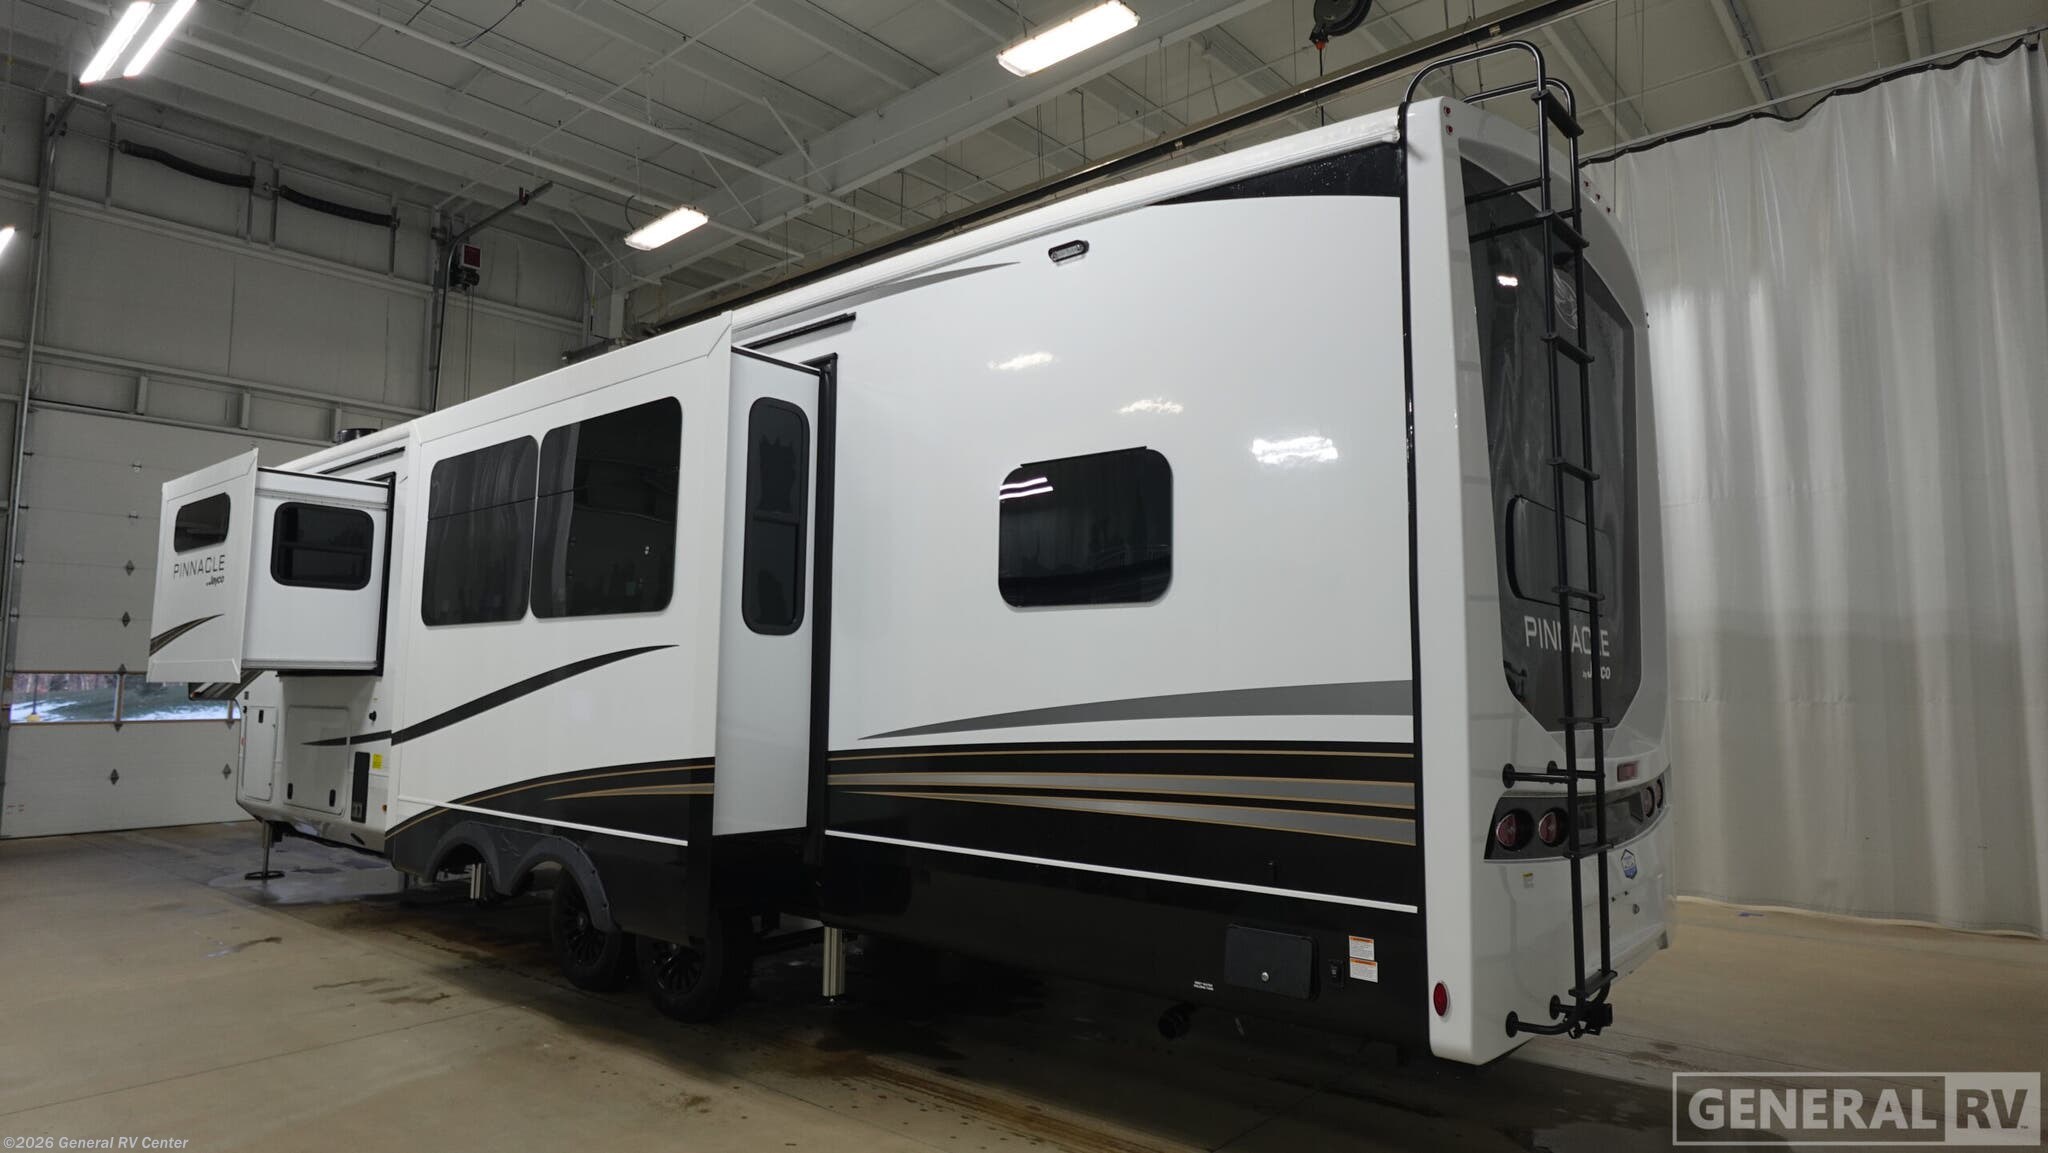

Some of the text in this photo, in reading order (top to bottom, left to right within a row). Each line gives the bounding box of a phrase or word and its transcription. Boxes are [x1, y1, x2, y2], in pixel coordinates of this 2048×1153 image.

[173, 555, 225, 580] PINNACLE
[1523, 615, 1610, 657] PINACE
[1587, 661, 1611, 680] Jco
